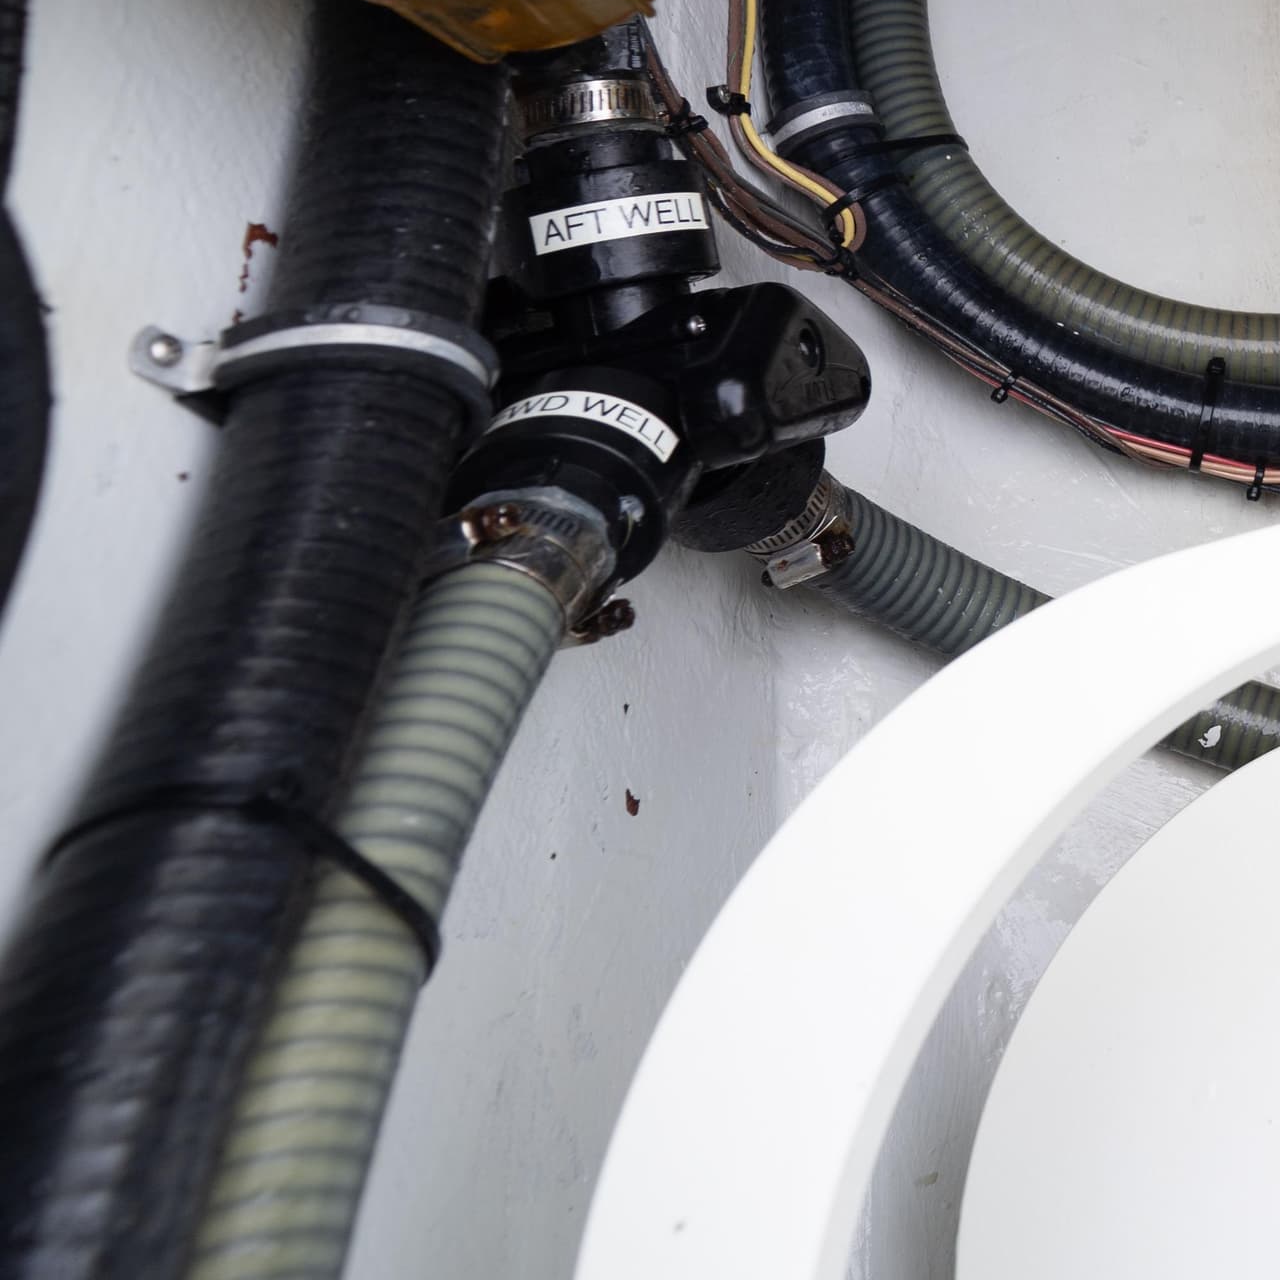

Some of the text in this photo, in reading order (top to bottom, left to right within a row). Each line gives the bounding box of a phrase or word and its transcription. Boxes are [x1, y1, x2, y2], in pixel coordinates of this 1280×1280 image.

[544, 198, 702, 247] AFT WELL
[582, 396, 667, 456] WELL
